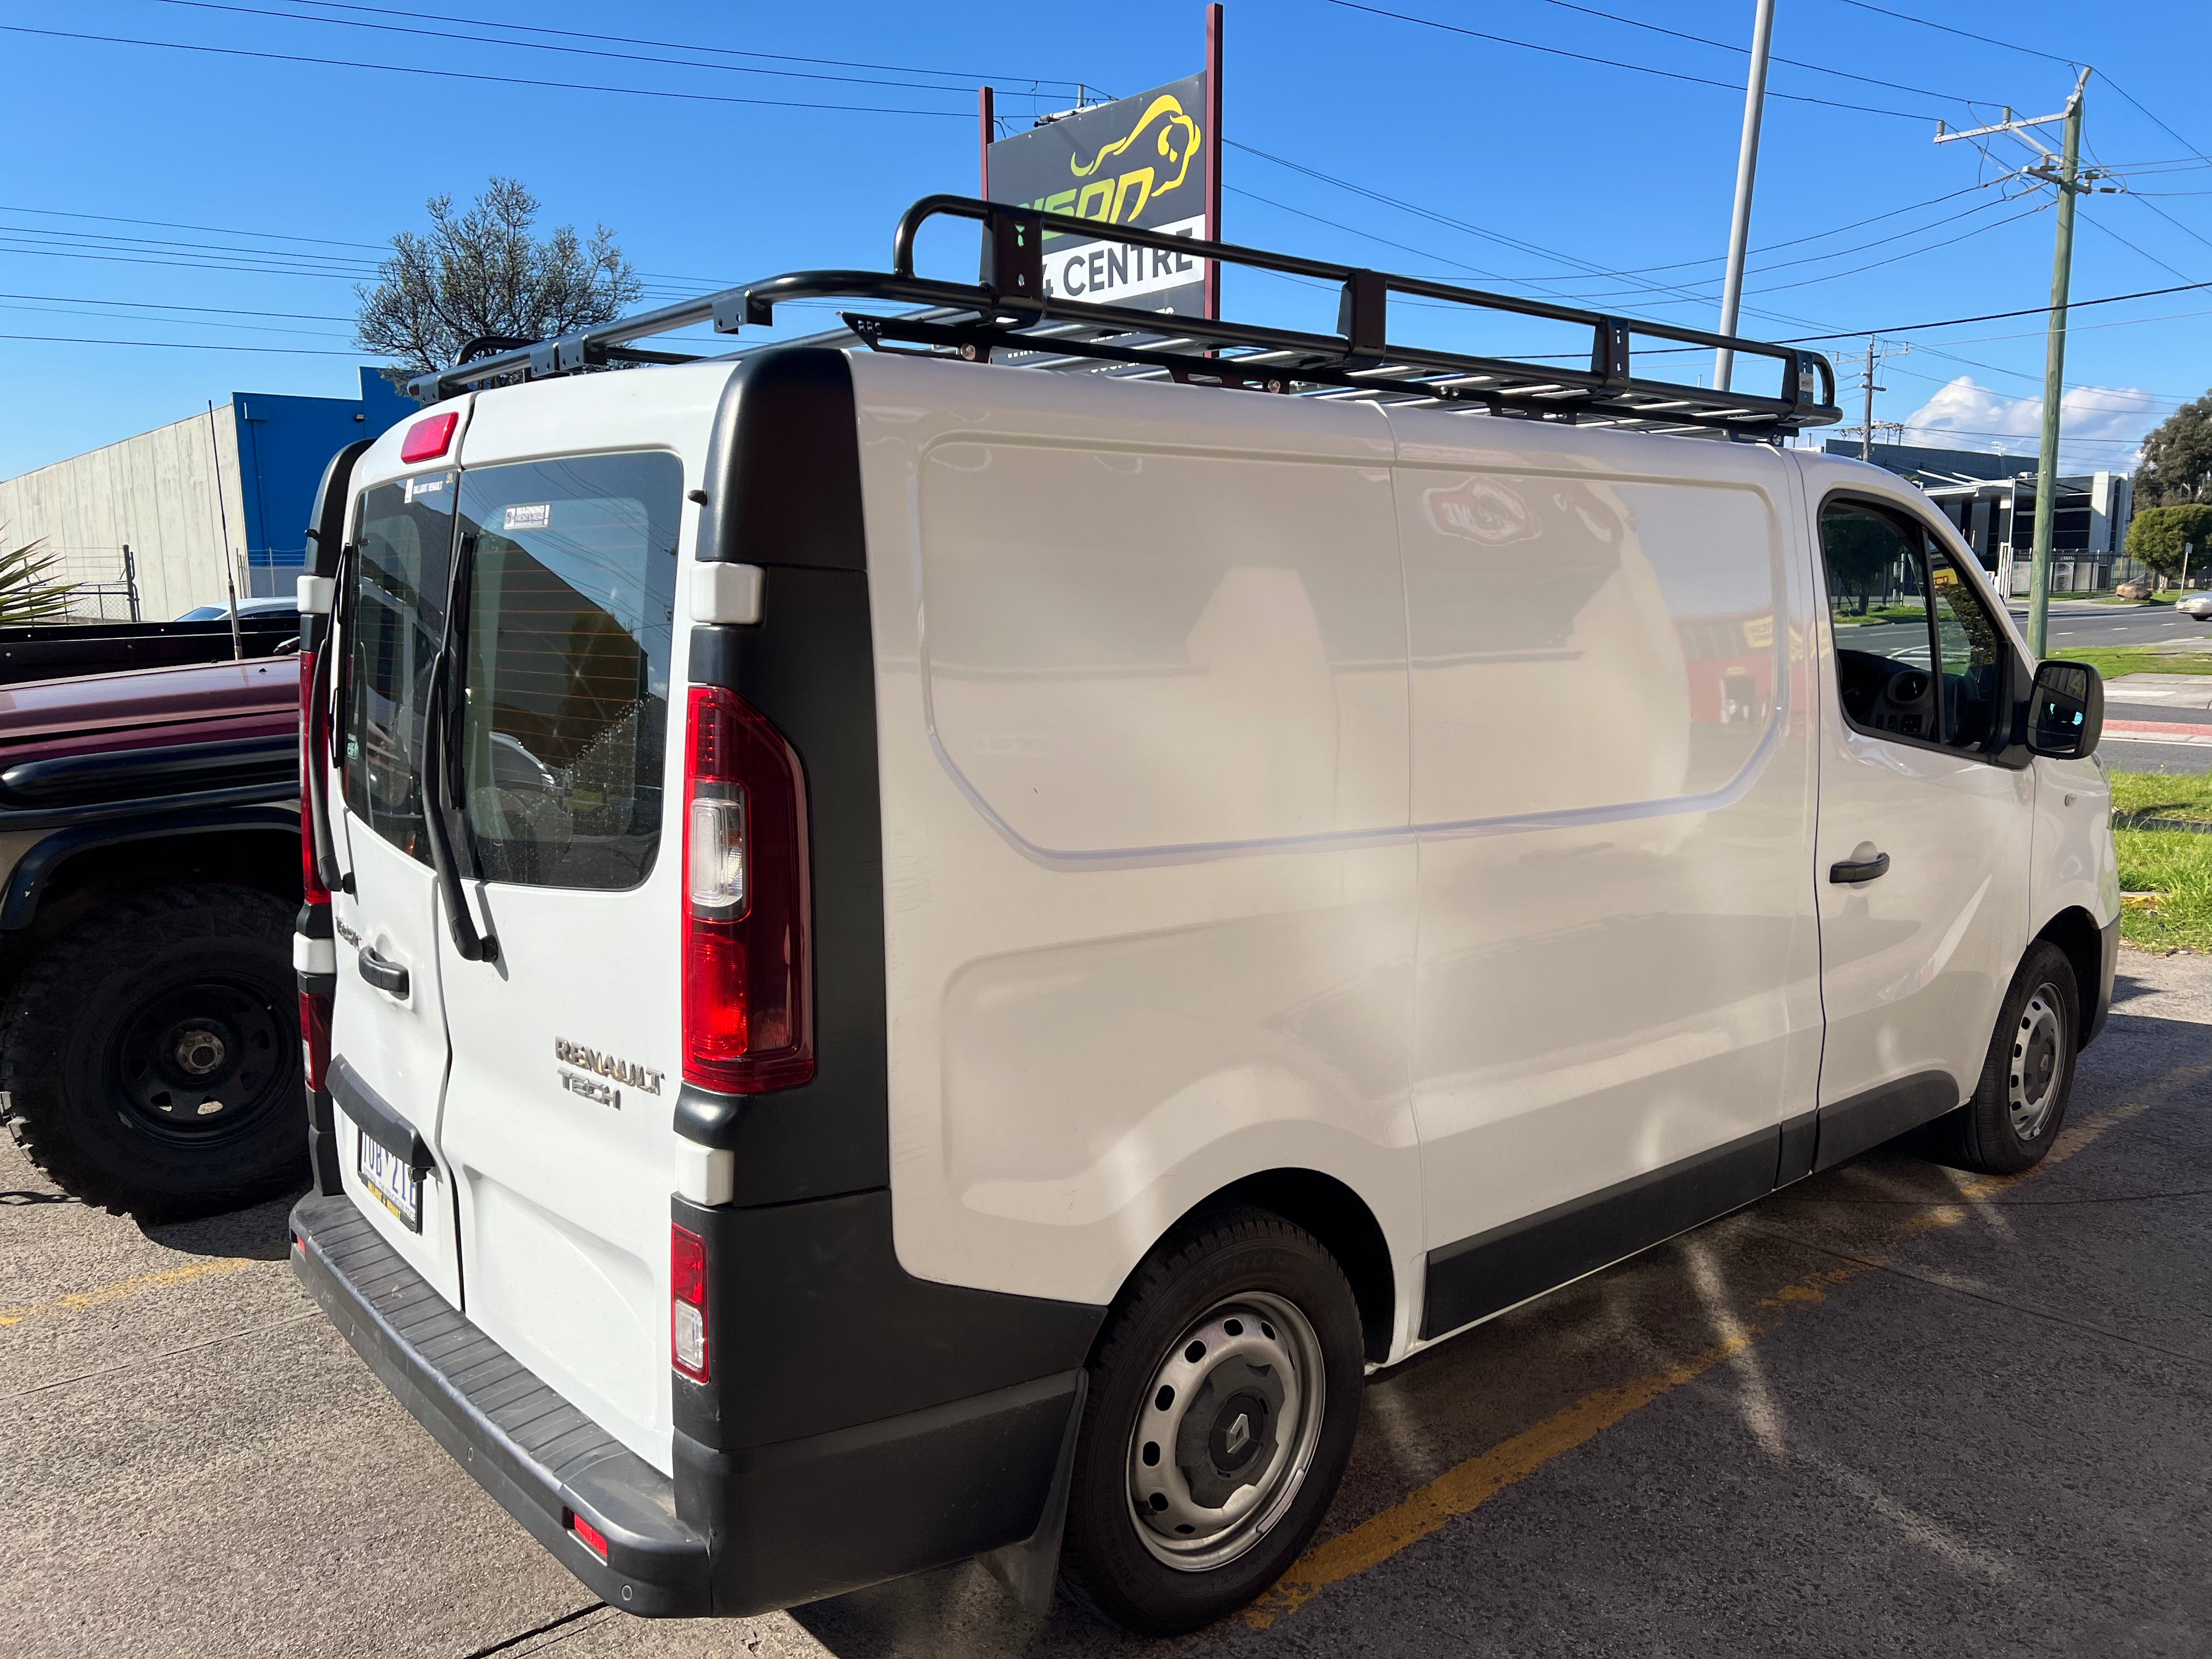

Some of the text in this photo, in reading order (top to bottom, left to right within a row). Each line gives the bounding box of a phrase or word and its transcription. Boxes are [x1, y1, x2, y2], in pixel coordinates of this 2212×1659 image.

[1063, 227, 1193, 296] CENTRE
[857, 320, 882, 336] RRS
[516, 505, 544, 515] WARNING
[555, 1036, 665, 1096] RENAULT
[557, 1068, 621, 1111] TECH
